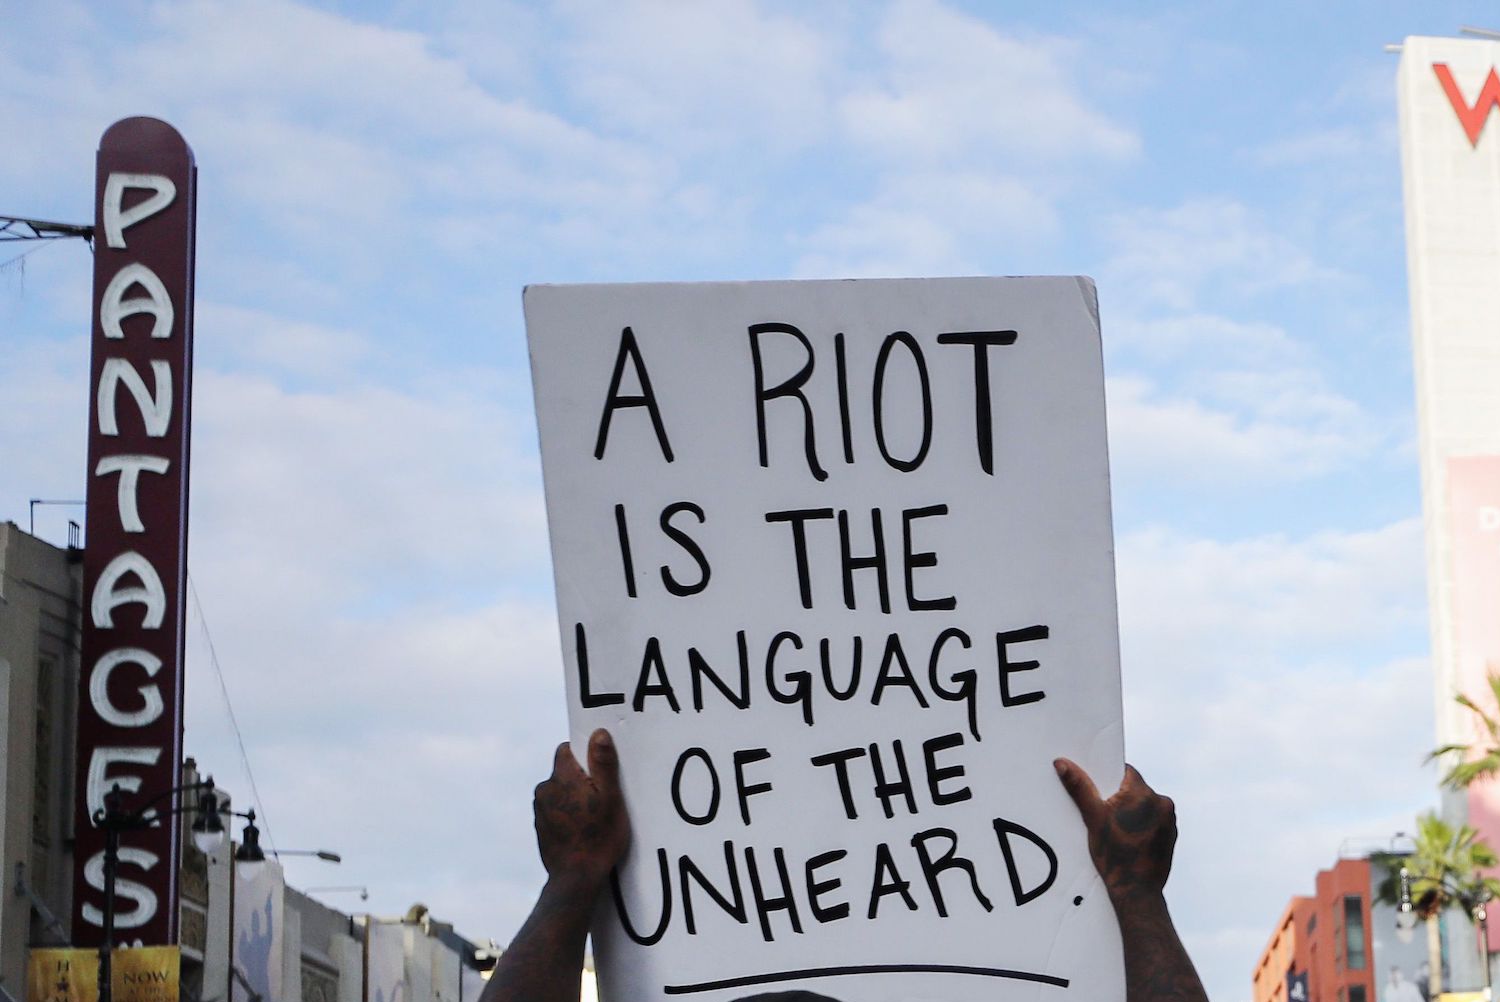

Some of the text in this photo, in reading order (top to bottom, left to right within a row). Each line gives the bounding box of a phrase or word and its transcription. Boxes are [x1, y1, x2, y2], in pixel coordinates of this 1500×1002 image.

[594, 322, 1018, 483] A RIOT
[82, 171, 177, 930] PANTAGES
[614, 501, 957, 614] IS THE
[575, 624, 1050, 742] LANGUAGE
[671, 732, 973, 826] OF THE
[611, 817, 1084, 948] UNHEARD.
[121, 970, 170, 986] NOW
